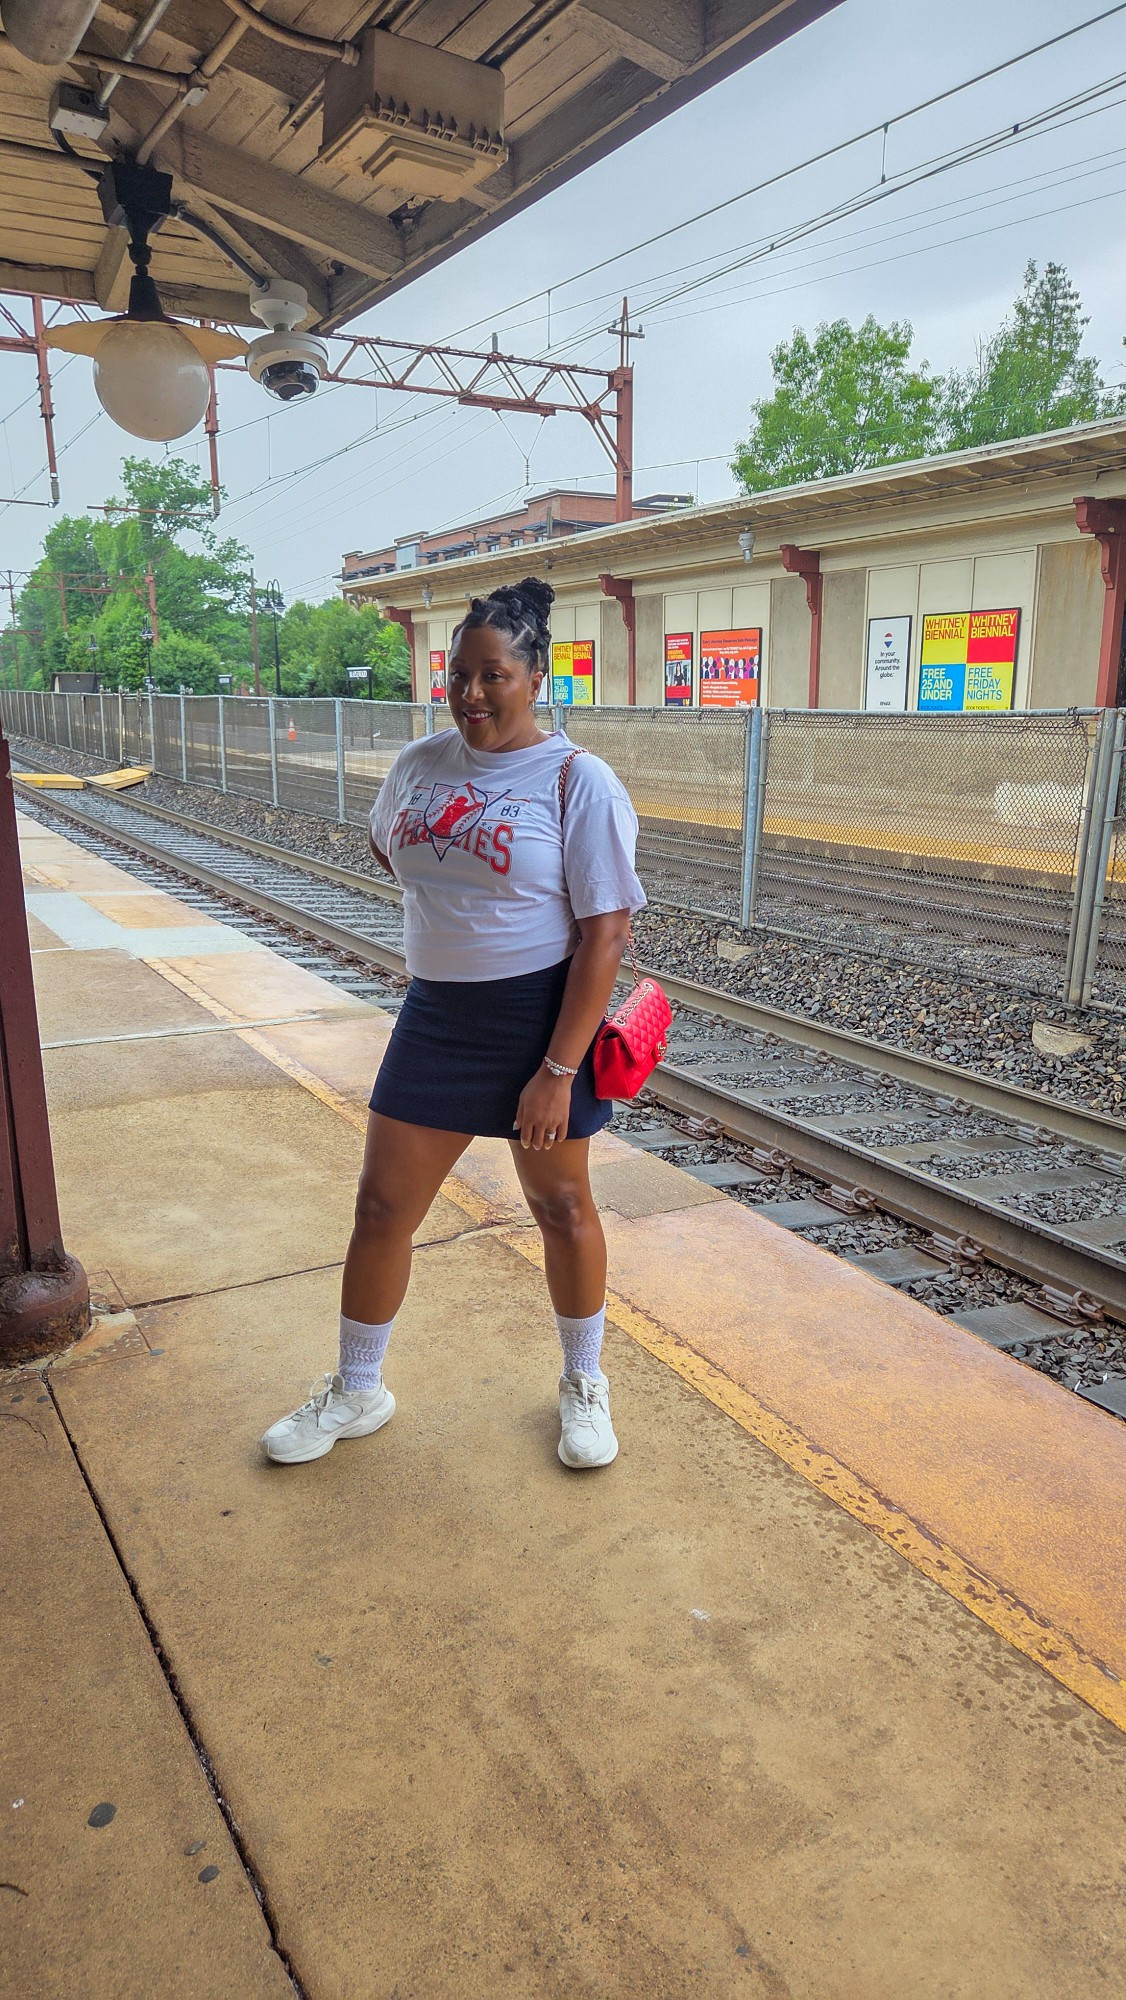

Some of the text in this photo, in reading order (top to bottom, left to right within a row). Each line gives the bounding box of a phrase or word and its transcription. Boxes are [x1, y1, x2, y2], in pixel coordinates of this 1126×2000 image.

[925, 617, 967, 630] WHITNEY
[972, 614, 1016, 626] WHITNEY
[925, 628, 965, 640] BIENNIAL
[971, 626, 1014, 638] BIENNIAL
[922, 668, 946, 679] FREE
[968, 667, 993, 678] FREE
[922, 679, 953, 690] 25 AND
[967, 678, 1001, 689] FRIDAY
[921, 689, 952, 701] UNDER
[966, 689, 1003, 701] NIGHTS
[408, 793, 422, 806] 18
[500, 805, 520, 818] 83
